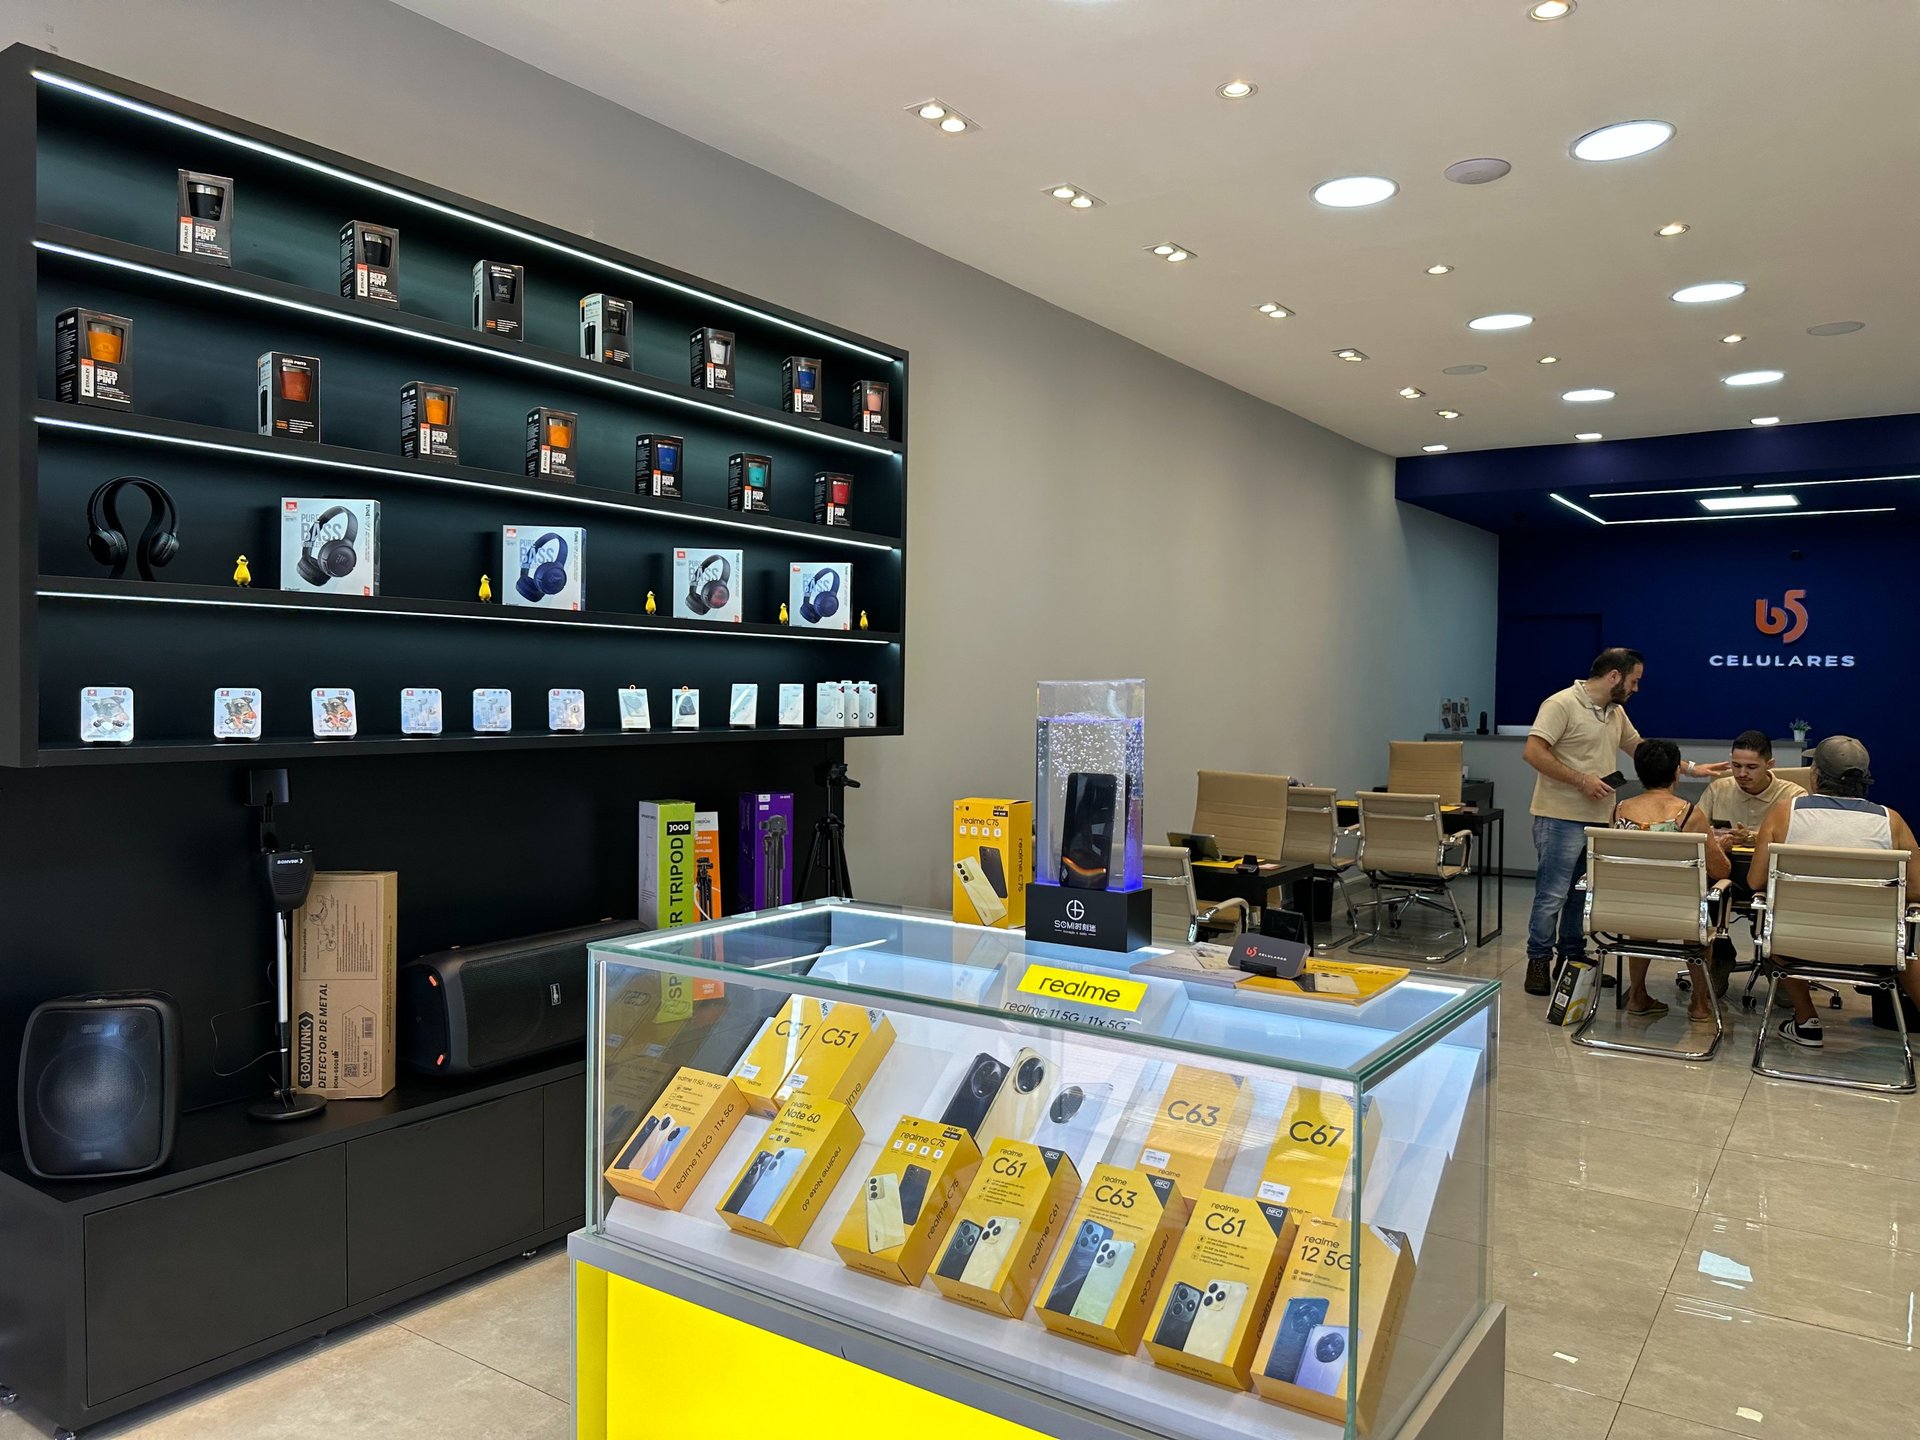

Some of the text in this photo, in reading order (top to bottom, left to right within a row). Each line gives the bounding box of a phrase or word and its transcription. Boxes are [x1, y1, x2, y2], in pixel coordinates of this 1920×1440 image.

[195, 233, 215, 241] PINT
[97, 368, 118, 379] BEER
[97, 376, 118, 386] PINT
[301, 523, 342, 542] BASS
[520, 547, 554, 563] BASS
[689, 568, 719, 581] BASS
[1709, 655, 1856, 667] CELULARES
[668, 824, 690, 833] JOOG
[960, 817, 1000, 827] realme C75
[670, 837, 684, 906] TRIPOD
[1038, 977, 1121, 1003] realme
[1003, 1001, 1048, 1017] realme
[1049, 1008, 1061, 1019] 11
[1061, 1011, 1080, 1022] 5G
[1088, 1015, 1106, 1028] 11x
[318, 983, 328, 1088] DETECTOR DE METAL
[775, 1019, 811, 1040] C51
[821, 1027, 860, 1049] C51
[300, 1023, 312, 1082] BOMVINK
[783, 1108, 821, 1124] Note 60
[1167, 1099, 1221, 1128] C63
[900, 1131, 929, 1144] realme
[929, 1137, 947, 1148] C75
[1289, 1120, 1346, 1148] C67
[672, 1102, 735, 1194] realme 11 5G 11x 5G
[1000, 1148, 1024, 1158] realme
[992, 1157, 1028, 1179] C61
[1158, 1168, 1182, 1178] realme
[801, 1146, 842, 1212] realme Note 60
[1101, 1175, 1128, 1186] realme
[1095, 1185, 1138, 1209] C63
[927, 1178, 960, 1240] realme C75
[1210, 1202, 1240, 1214] realme
[1266, 1207, 1283, 1217] NFC
[1205, 1212, 1247, 1238] C61
[1028, 1203, 1061, 1270] realme C61
[1304, 1235, 1340, 1249] realme
[1150, 1233, 1170, 1278] realme
[1301, 1245, 1353, 1271] 12 5G
